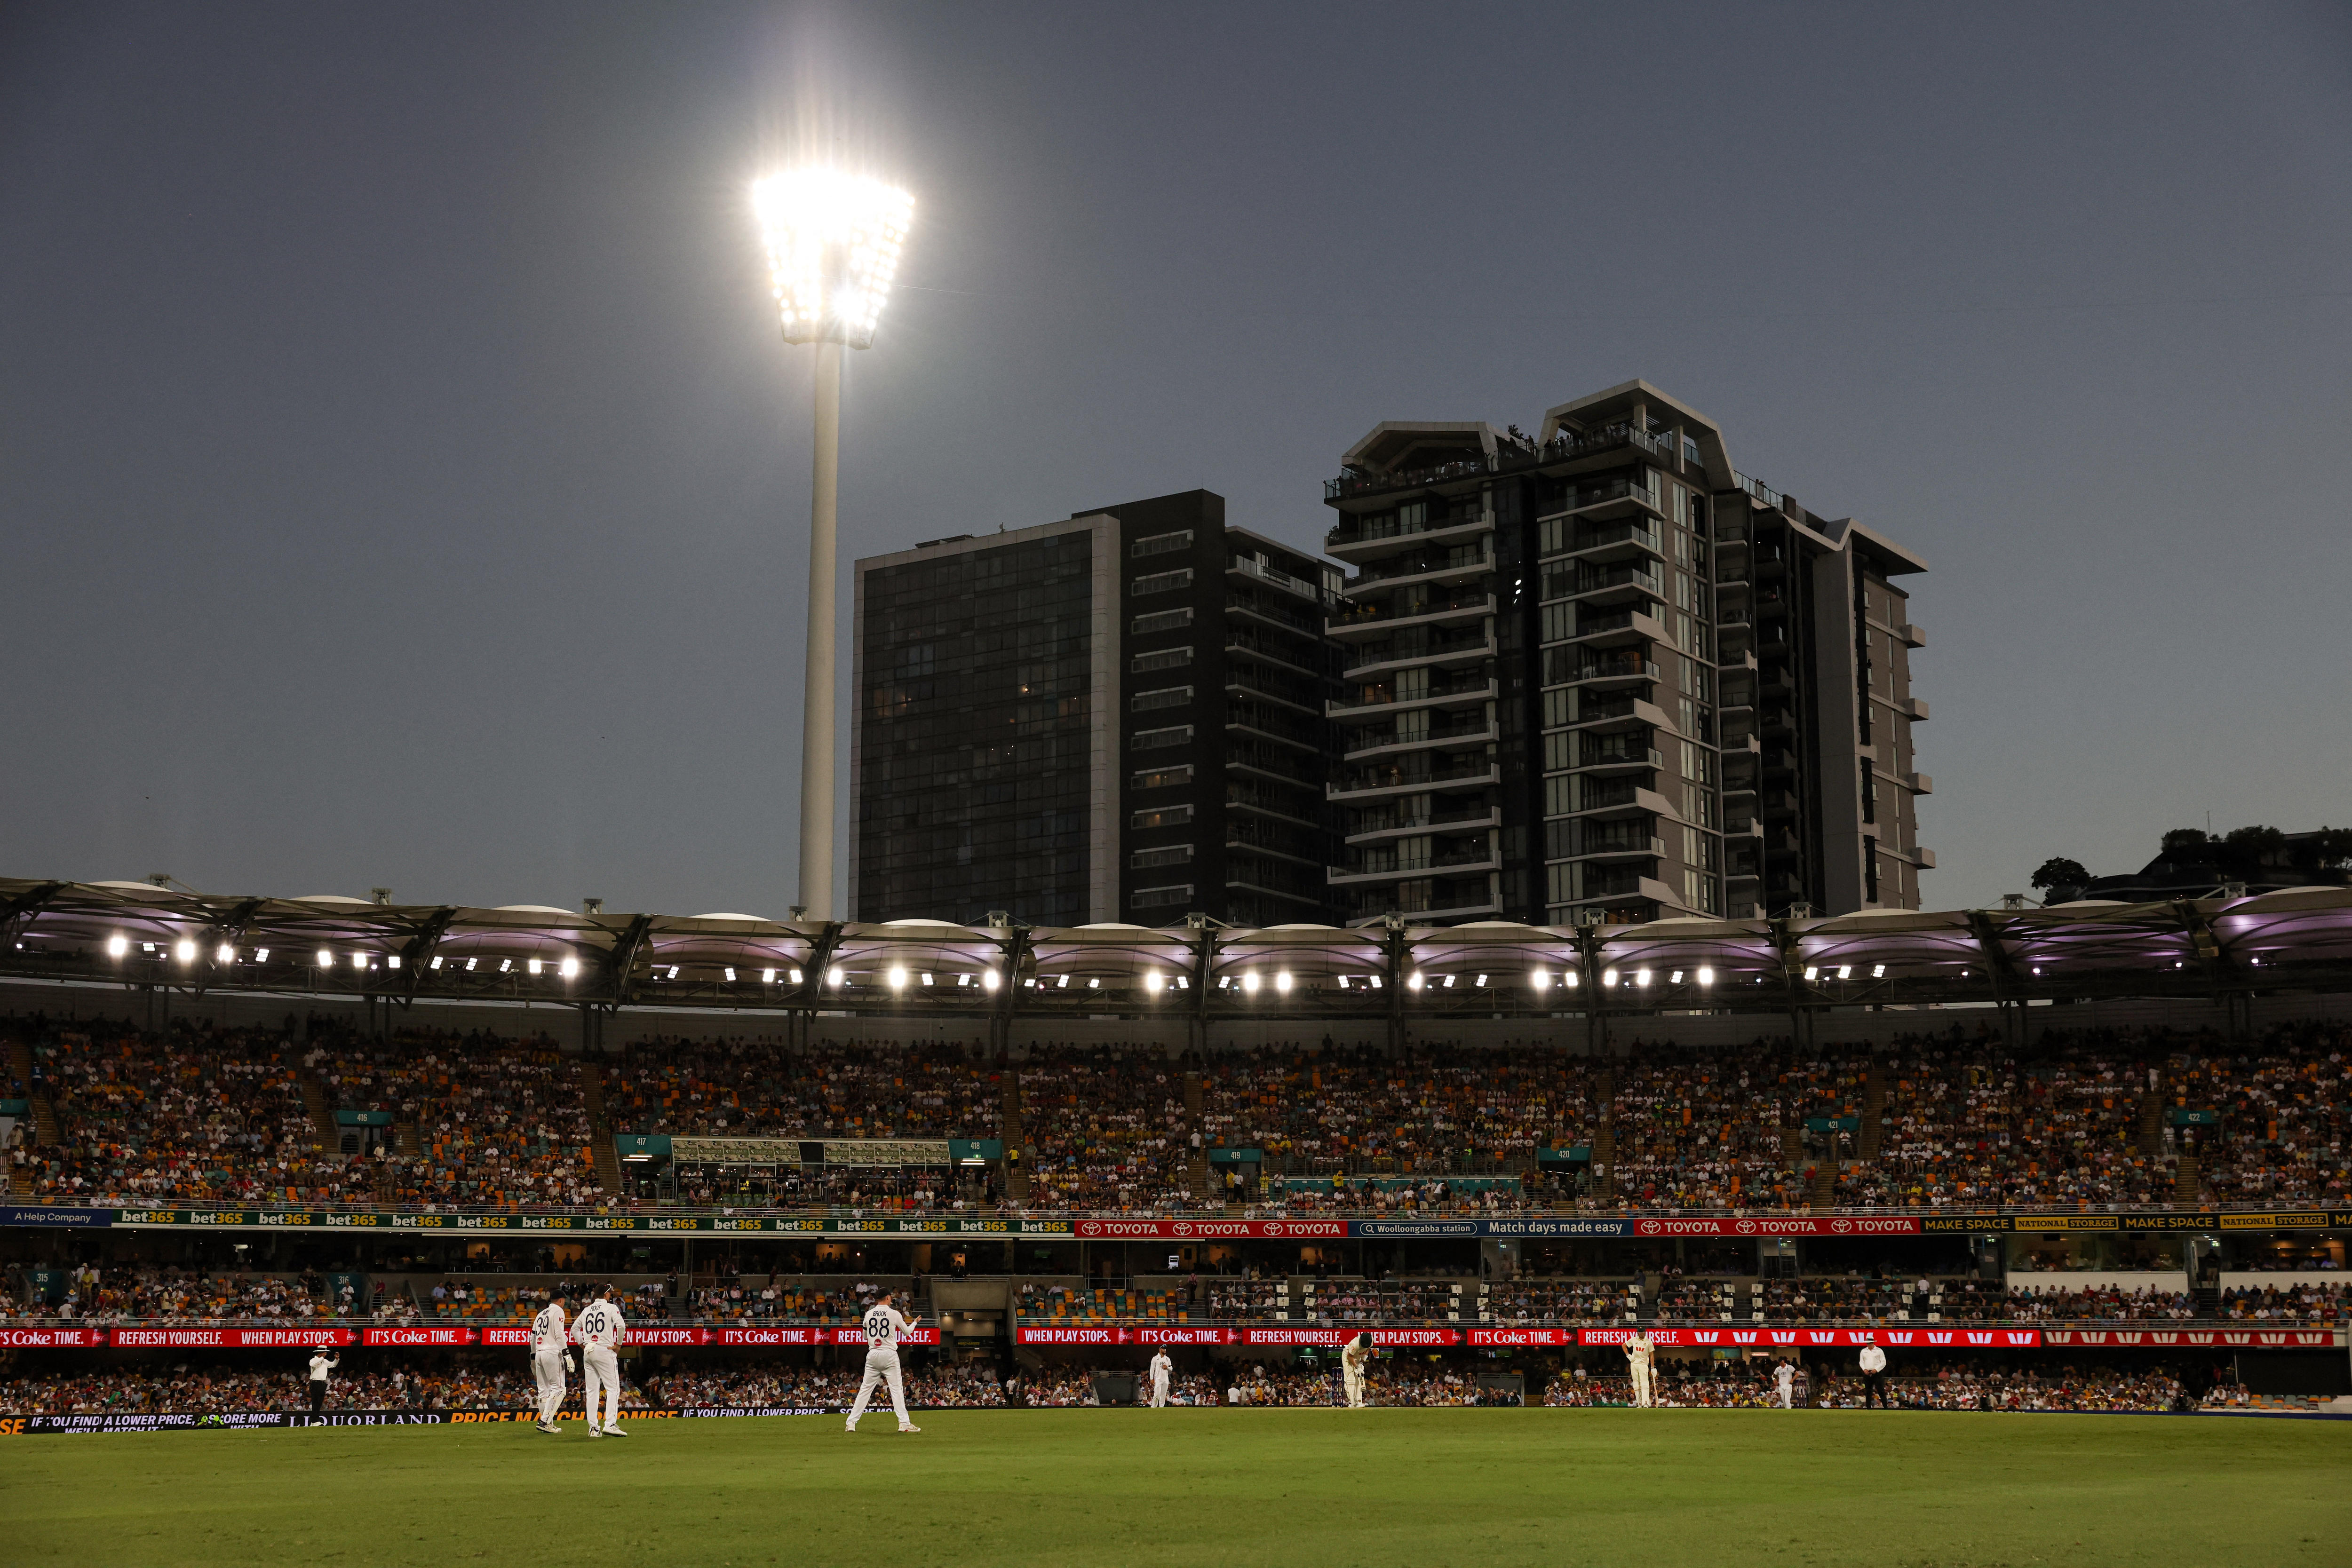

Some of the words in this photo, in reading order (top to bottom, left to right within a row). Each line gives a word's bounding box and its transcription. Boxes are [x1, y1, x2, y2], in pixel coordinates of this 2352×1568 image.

[24, 1213, 46, 1223] Help
[48, 1213, 91, 1223] Company
[122, 1210, 175, 1223] bet365
[191, 1212, 243, 1224] bet365
[259, 1213, 310, 1225] bet365
[326, 1214, 377, 1226] bet365
[392, 1215, 442, 1227] bet365
[458, 1216, 508, 1227] bet365
[2126, 1218, 2165, 1227] MAKE
[2168, 1217, 2214, 1227] SPACE
[522, 1217, 571, 1228] bet365
[586, 1218, 634, 1228] bet365
[649, 1218, 697, 1229] bet365
[714, 1219, 762, 1230] bet365
[776, 1220, 823, 1230] bet365
[838, 1220, 884, 1231] bet365
[899, 1220, 946, 1231] bet365
[961, 1220, 1007, 1231] bet365
[1021, 1220, 1067, 1232] bet365
[1489, 1222, 1525, 1233] Match
[1529, 1221, 1556, 1235] days
[1560, 1221, 1591, 1232] made
[1595, 1224, 1622, 1234] easy
[1665, 1222, 1720, 1233] TOYOTA
[1760, 1221, 1816, 1232] TOYOTA
[1856, 1220, 1913, 1231] TOYOTA
[1925, 1220, 1963, 1230] MAKE
[1965, 1219, 2009, 1229] SPACE
[2070, 1219, 2114, 1227] STORAGE
[1105, 1224, 1159, 1234] TOYOTA
[1196, 1224, 1249, 1234] TOYOTA
[1287, 1224, 1340, 1234] TOYOTA
[1377, 1225, 1440, 1234] Woolloongabba
[1442, 1224, 1470, 1232] station
[37, 1273, 48, 1282] 315
[536, 1316, 549, 1336] 39
[586, 1312, 605, 1334] 66
[869, 1318, 890, 1338] 88
[12, 1331, 51, 1345] Coke
[55, 1332, 84, 1345] TIME.
[119, 1332, 167, 1344] REFRESH
[169, 1332, 223, 1344] YOURSELF.
[242, 1332, 272, 1344] WHEN
[276, 1332, 301, 1344] PLAY
[303, 1331, 337, 1343] STOPS.
[371, 1331, 389, 1343] IT'S
[392, 1330, 427, 1343] Coke
[430, 1331, 457, 1343] TIME.
[636, 1331, 659, 1343] PLAY
[661, 1331, 694, 1343] STOPS.
[726, 1331, 743, 1343] IT'S
[746, 1330, 779, 1343] Coke
[782, 1331, 808, 1342] TIME.
[1025, 1330, 1053, 1342] WHEN
[1056, 1330, 1078, 1342] PLAY
[1080, 1330, 1111, 1342] STOPS.
[1141, 1330, 1158, 1342] IT'S
[1160, 1330, 1192, 1342] Coke
[1195, 1331, 1221, 1342] TIME.
[1251, 1331, 1291, 1343] REFRESH
[1294, 1331, 1342, 1343] YOURSELF.
[1388, 1332, 1410, 1343] PLAY
[1413, 1332, 1444, 1343] STOPS.
[1475, 1332, 1491, 1343] IT'S
[1494, 1331, 1526, 1343] Coke
[1529, 1332, 1555, 1343] TIME.
[1586, 1331, 1627, 1343] REFRESH
[248, 1413, 281, 1423] MORE
[450, 1412, 511, 1423] PRICE
[697, 1409, 719, 1418] YOU
[31, 1417, 44, 1427] IF
[72, 1416, 102, 1426] FIND
[104, 1416, 113, 1425] A
[115, 1415, 155, 1425] LOWER
[158, 1414, 195, 1426] PRICE,
